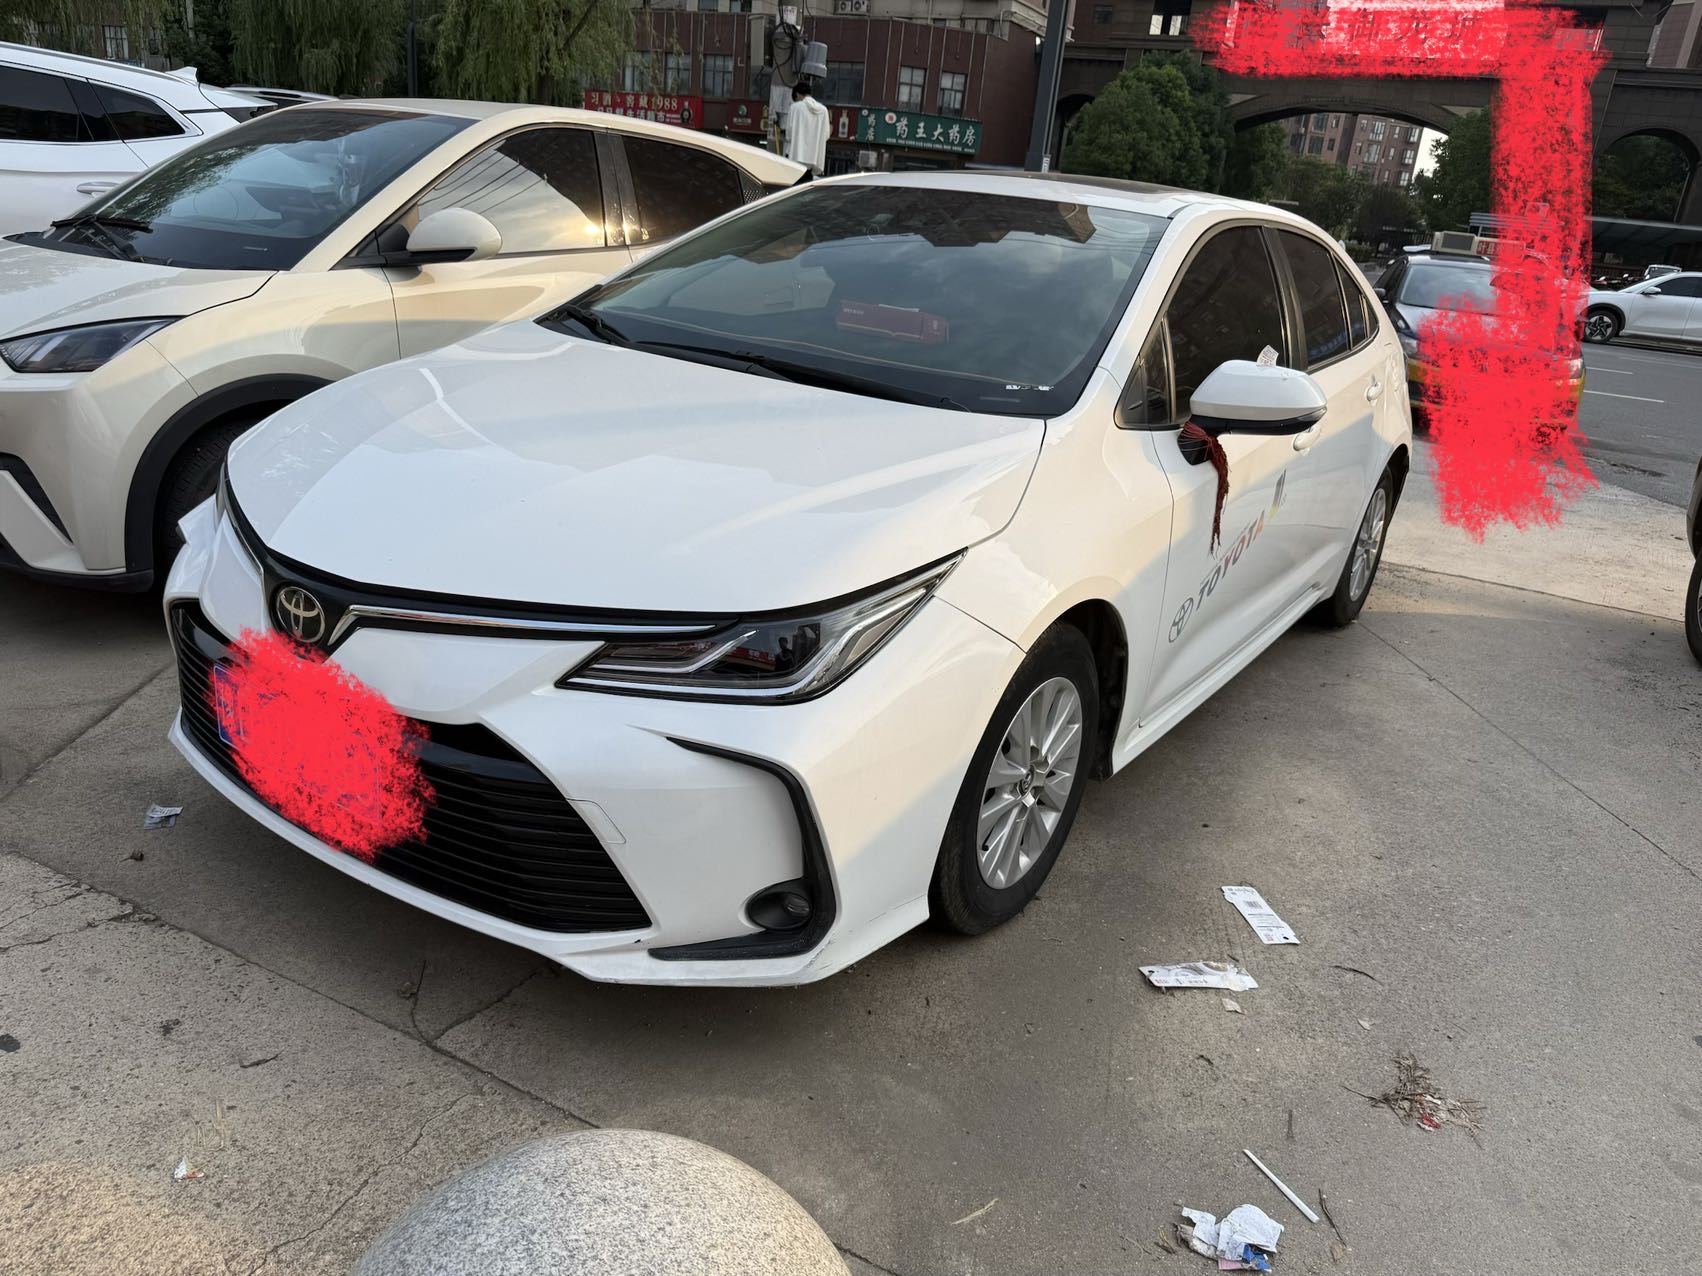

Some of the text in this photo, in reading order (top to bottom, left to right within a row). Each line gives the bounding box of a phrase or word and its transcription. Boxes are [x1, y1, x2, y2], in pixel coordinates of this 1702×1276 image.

[895, 116, 976, 146] 药王大药房
[1196, 510, 1265, 611] TOYOTA
